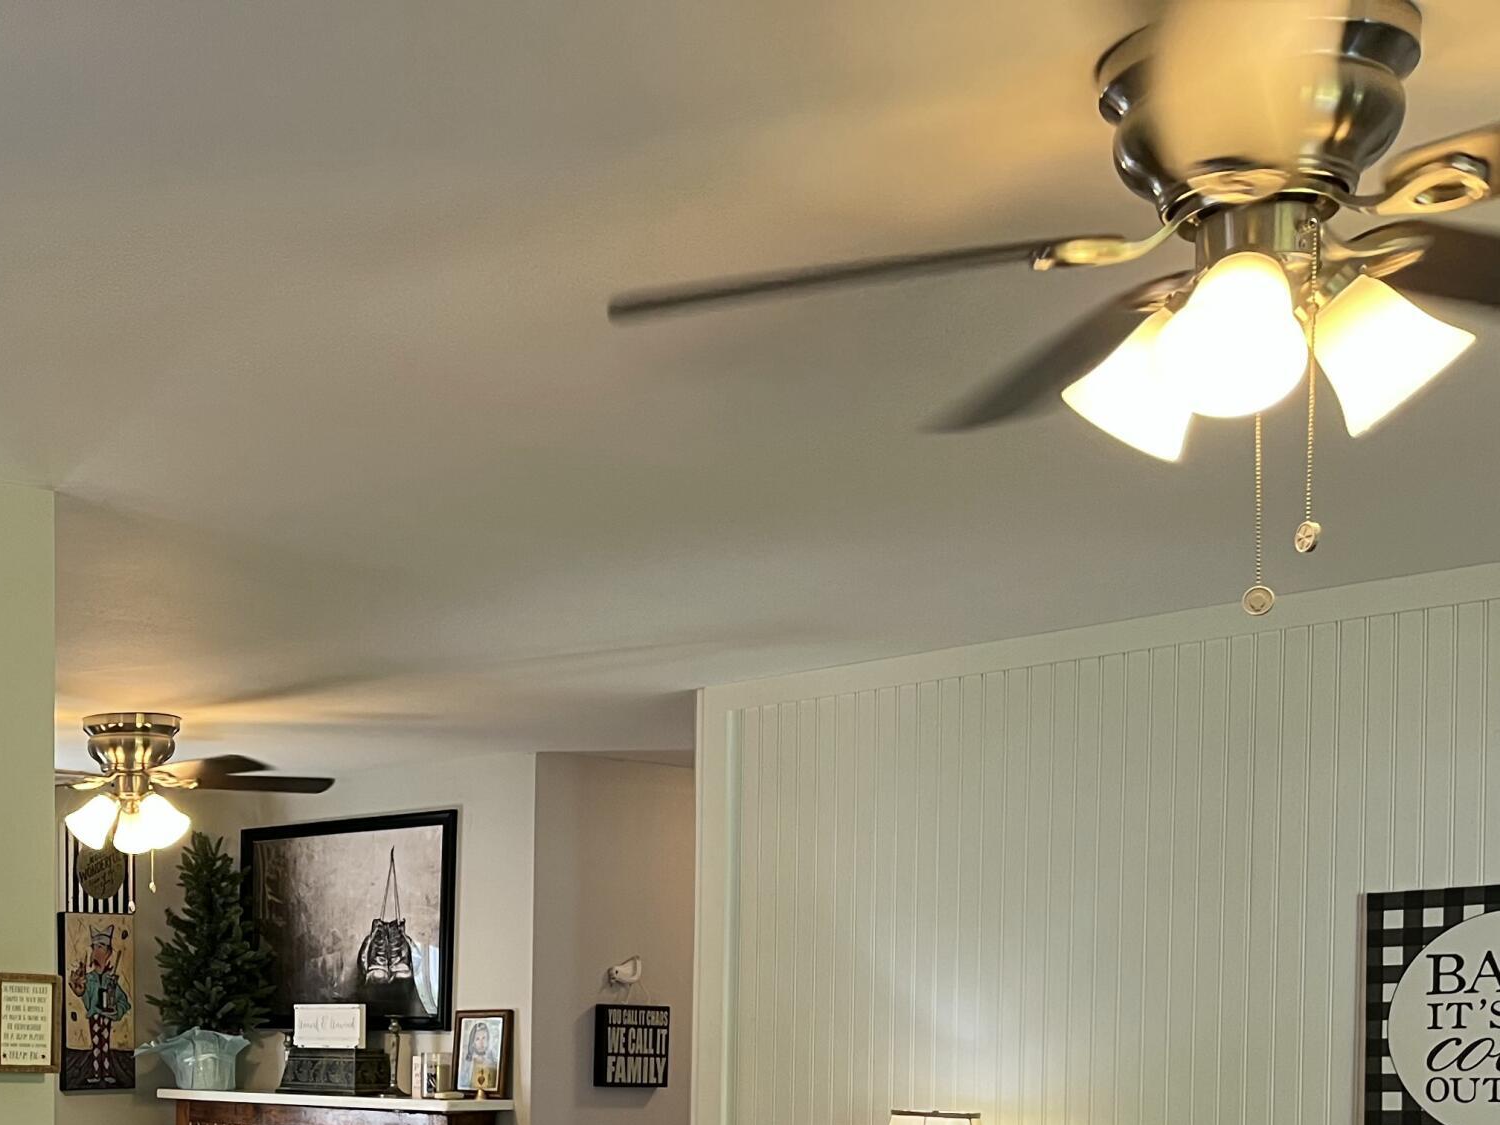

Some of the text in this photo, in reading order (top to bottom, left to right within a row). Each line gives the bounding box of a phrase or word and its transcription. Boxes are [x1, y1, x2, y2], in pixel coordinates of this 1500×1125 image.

[607, 1008, 668, 1027] YOU CALL IT CHAOS
[607, 1026, 668, 1055] WE CALL IT
[1426, 1037, 1500, 1072] co
[606, 1055, 667, 1084] FAMILY
